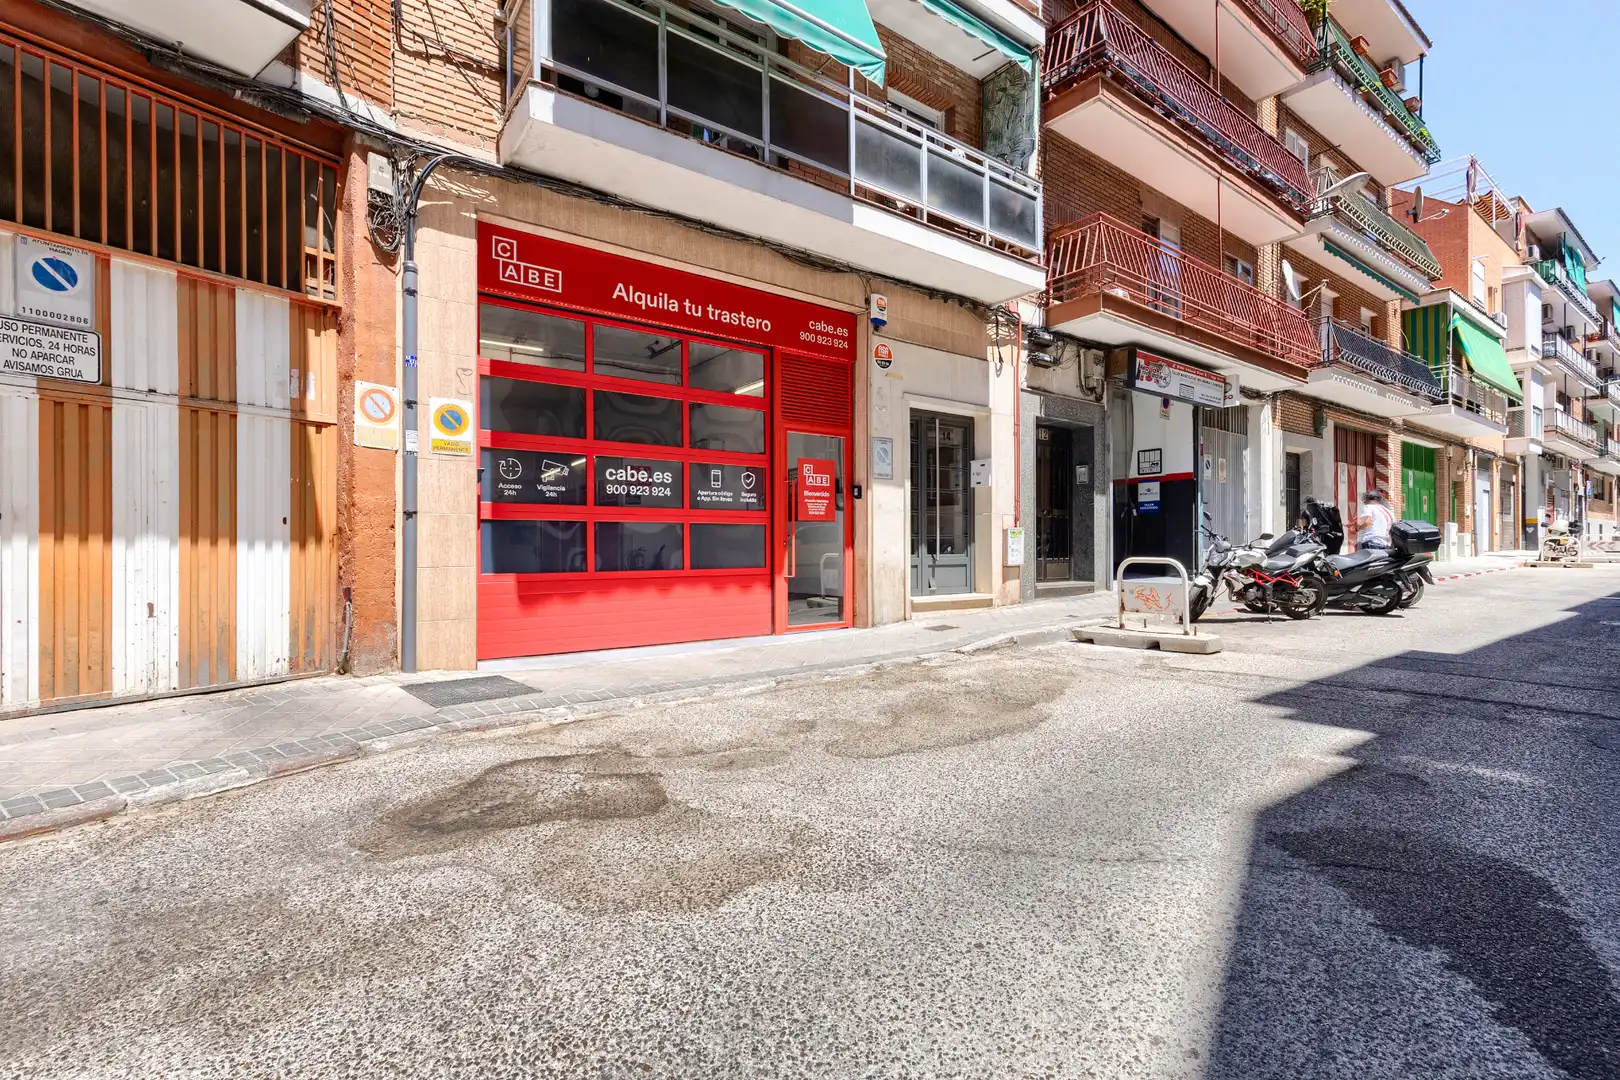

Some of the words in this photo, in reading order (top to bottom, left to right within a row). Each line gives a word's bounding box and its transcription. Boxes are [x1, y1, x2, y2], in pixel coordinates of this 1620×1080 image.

[31, 238, 80, 254] AYUNTAMIENTO
[48, 247, 73, 256] MADRID
[21, 306, 89, 325] 1100002806
[612, 282, 679, 313] Alquila
[683, 298, 702, 317] tu
[706, 303, 772, 332] trastero
[21, 323, 89, 343] PERMANENTE
[808, 320, 849, 337] cabe.es
[48, 340, 60, 351] 24
[63, 343, 96, 357] HORAS
[799, 330, 816, 343] 900
[816, 335, 832, 346] 923
[833, 338, 849, 350] 924
[12, 347, 28, 359] NO
[30, 350, 75, 366] APARCAR
[3, 359, 54, 375] AVISAMOS
[56, 366, 84, 379] GRUA
[941, 431, 951, 441] 14
[1039, 428, 1049, 440] 12
[605, 465, 673, 484] cabe.es
[536, 483, 566, 492] Vigilancia
[606, 483, 628, 495] 900
[629, 485, 650, 496] 923
[651, 486, 671, 497] 924
